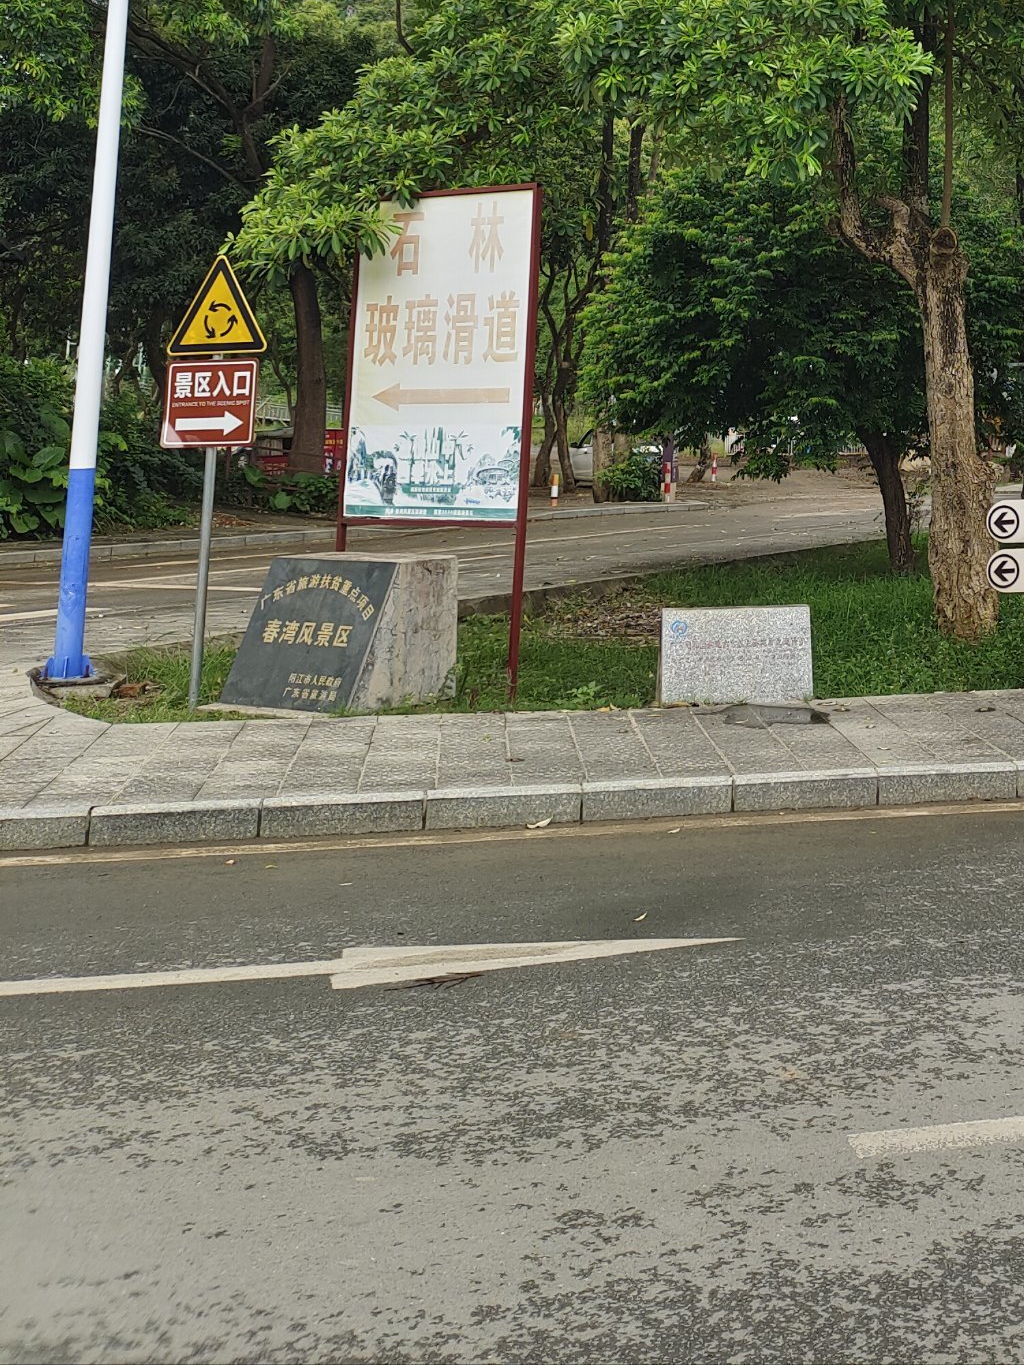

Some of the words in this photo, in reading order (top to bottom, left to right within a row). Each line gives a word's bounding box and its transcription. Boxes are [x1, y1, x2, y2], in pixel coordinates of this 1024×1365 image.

[363, 290, 520, 366] 玻璃滑道
[174, 370, 251, 399] 景区入口
[261, 573, 375, 621] 广东省旅游扶贫重点项目
[262, 618, 353, 647] 春湾风景区
[288, 673, 342, 689] 阳江市人民政府
